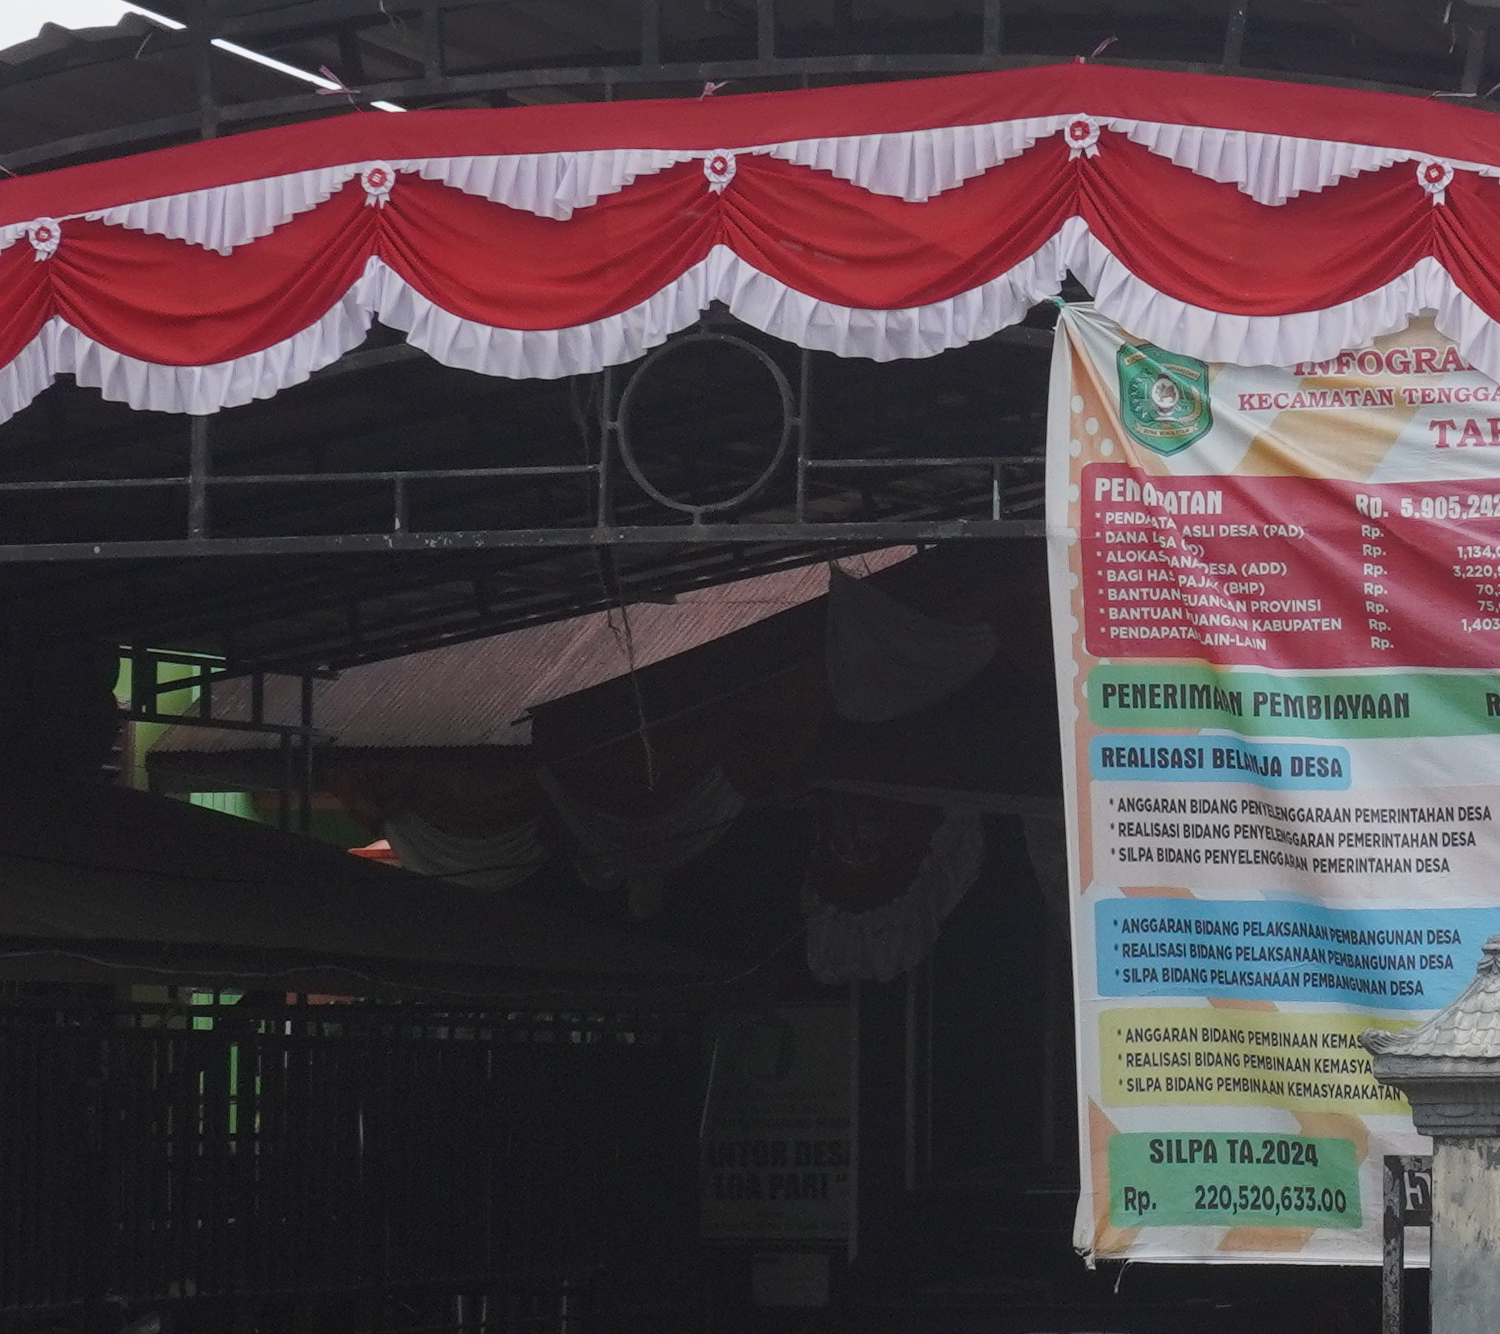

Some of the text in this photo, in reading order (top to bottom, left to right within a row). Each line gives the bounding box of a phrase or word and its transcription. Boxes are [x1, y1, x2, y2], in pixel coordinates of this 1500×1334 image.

[1237, 388, 1394, 412] KECAMATAN
[1356, 493, 1390, 519] Rp.
[1253, 691, 1411, 721] PEMBIAYAAN
[1101, 746, 1204, 770] REALISASI
[1290, 754, 1343, 779] DESA
[1117, 797, 1187, 814] ANGGARAN
[1190, 798, 1239, 815] BIDANG
[1241, 799, 1352, 824] PENYELENGGARAAN
[1354, 807, 1455, 824] PEMERINTAHAN
[1457, 805, 1492, 823] DESA
[1121, 918, 1193, 936] ANGGARAN
[1194, 920, 1240, 937] BIDANG
[1243, 920, 1329, 943] PELAKSANAAN
[1329, 927, 1424, 946] PEMBANGUNAN
[1426, 928, 1461, 945] DESA
[1149, 1138, 1319, 1168] SILPA TA.2024
[1124, 1184, 1347, 1216] Rp. 220,520,633.00
